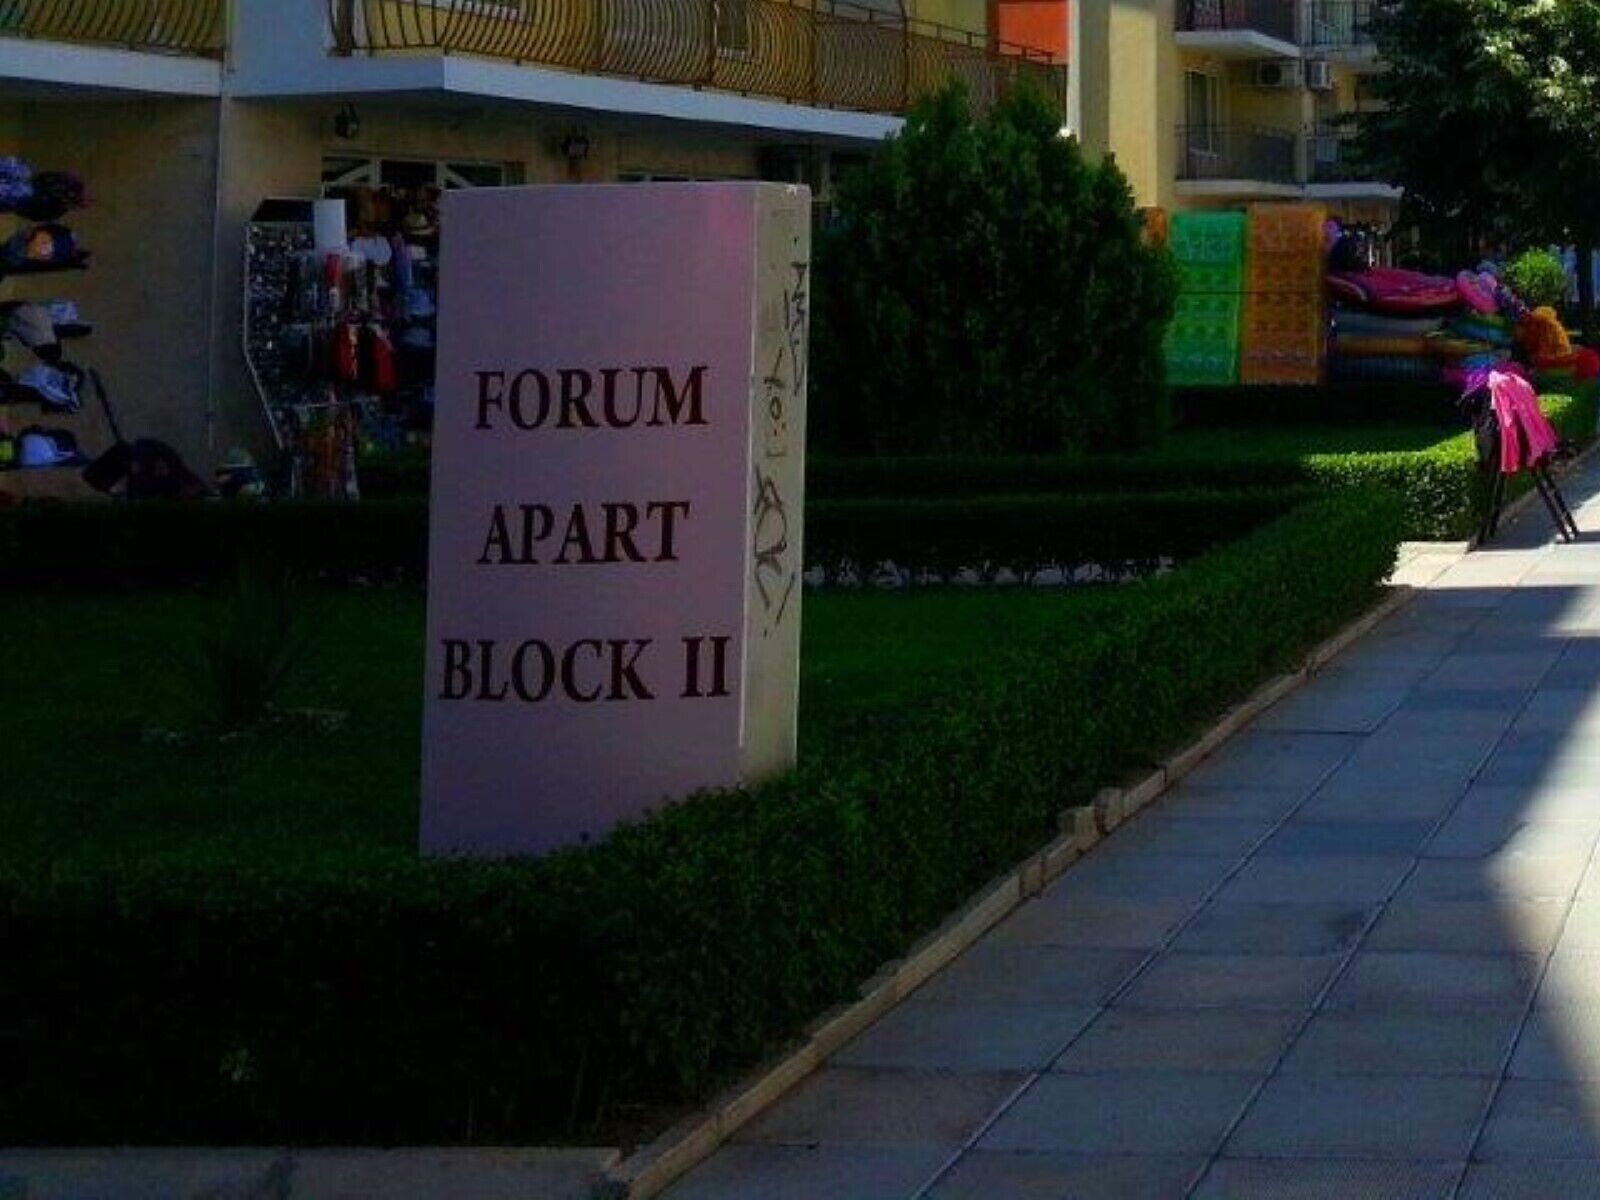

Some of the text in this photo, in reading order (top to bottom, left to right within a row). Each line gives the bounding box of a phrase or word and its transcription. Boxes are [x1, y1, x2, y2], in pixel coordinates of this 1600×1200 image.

[474, 366, 707, 430] FORUM
[477, 503, 689, 564] APART
[439, 637, 731, 701] BLOCK II
